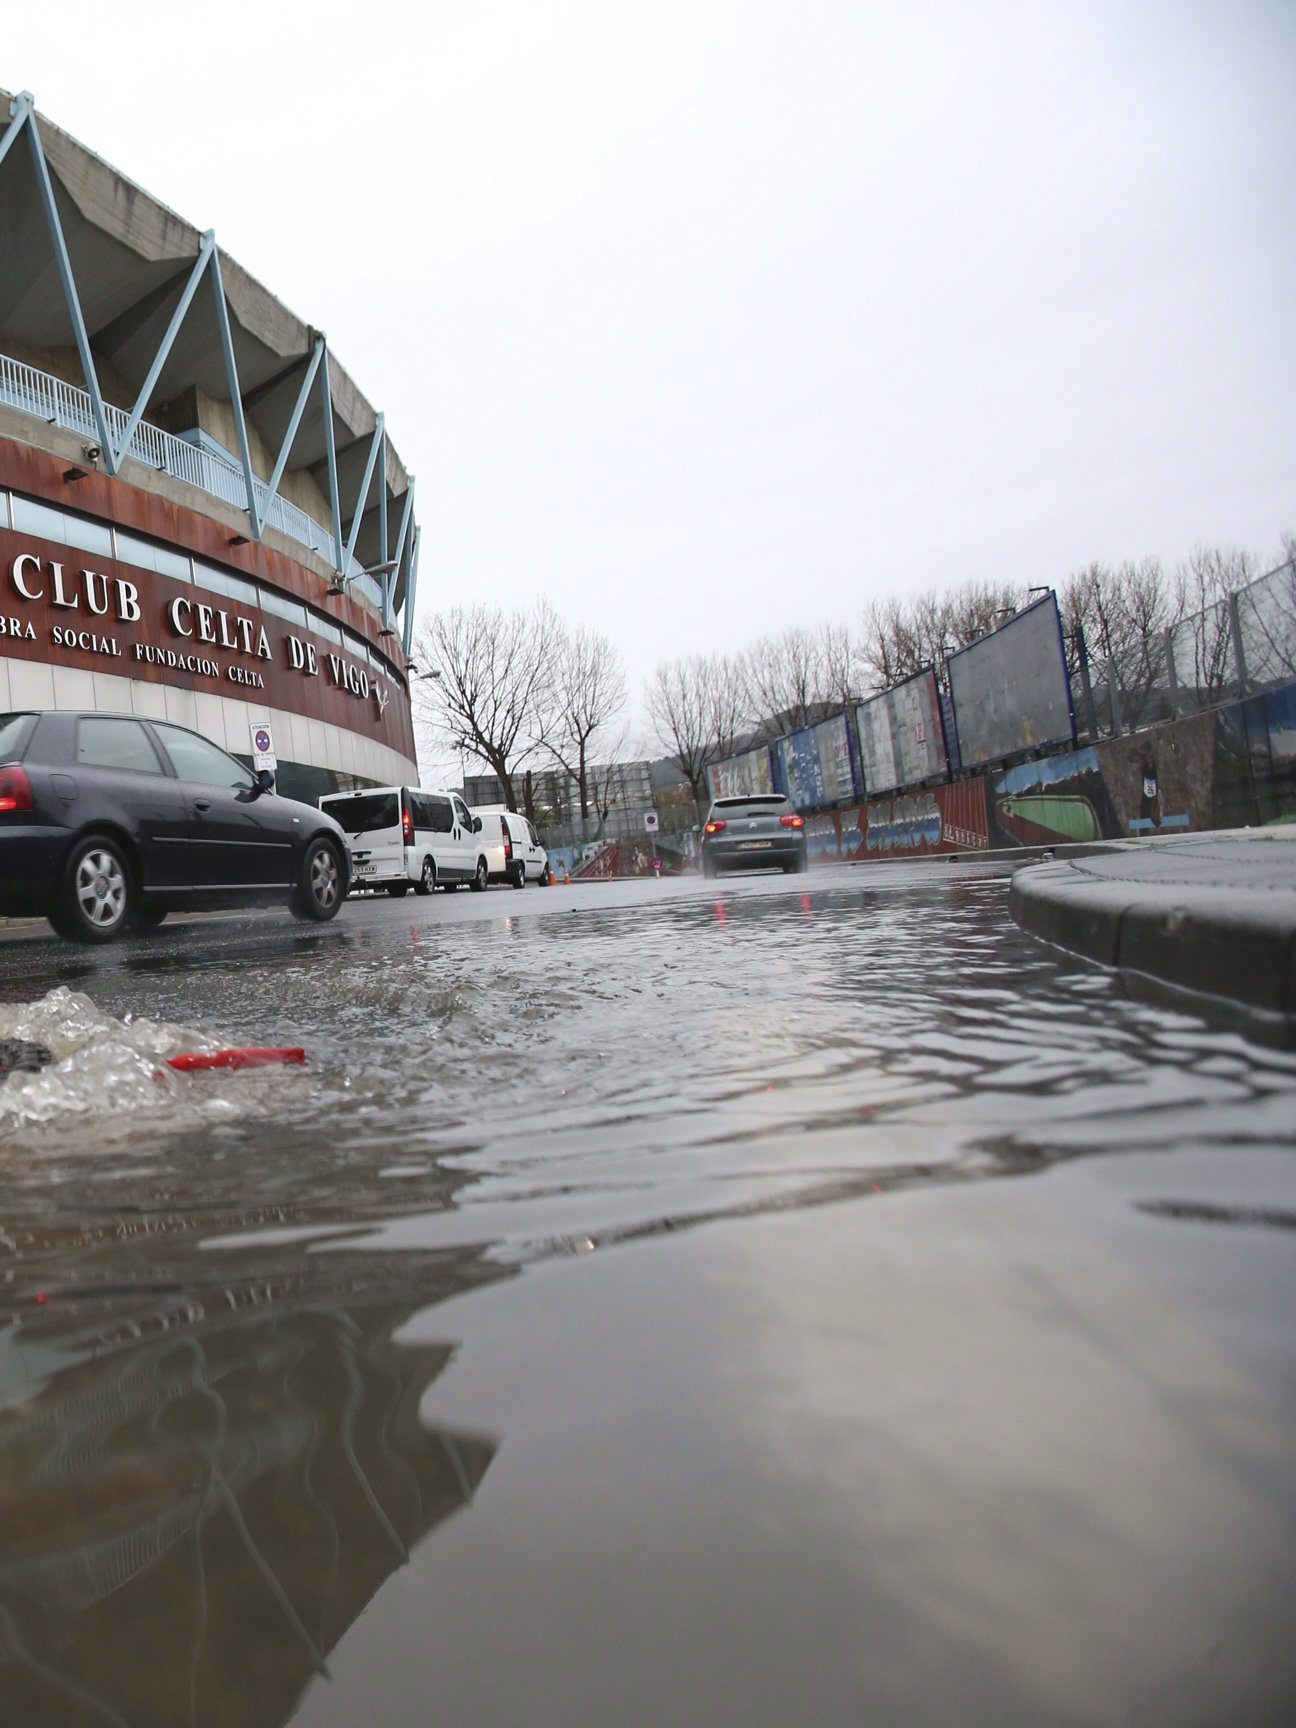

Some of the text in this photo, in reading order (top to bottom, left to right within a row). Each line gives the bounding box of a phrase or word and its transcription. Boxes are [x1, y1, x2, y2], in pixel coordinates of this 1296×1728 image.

[11, 553, 142, 622] CLUB
[171, 596, 273, 661] CELTA
[288, 635, 319, 676] DE
[329, 653, 369, 699] VIGO
[53, 625, 122, 656] SOCIAL
[135, 643, 220, 677] FUNDACION
[228, 665, 265, 689] CELTA
